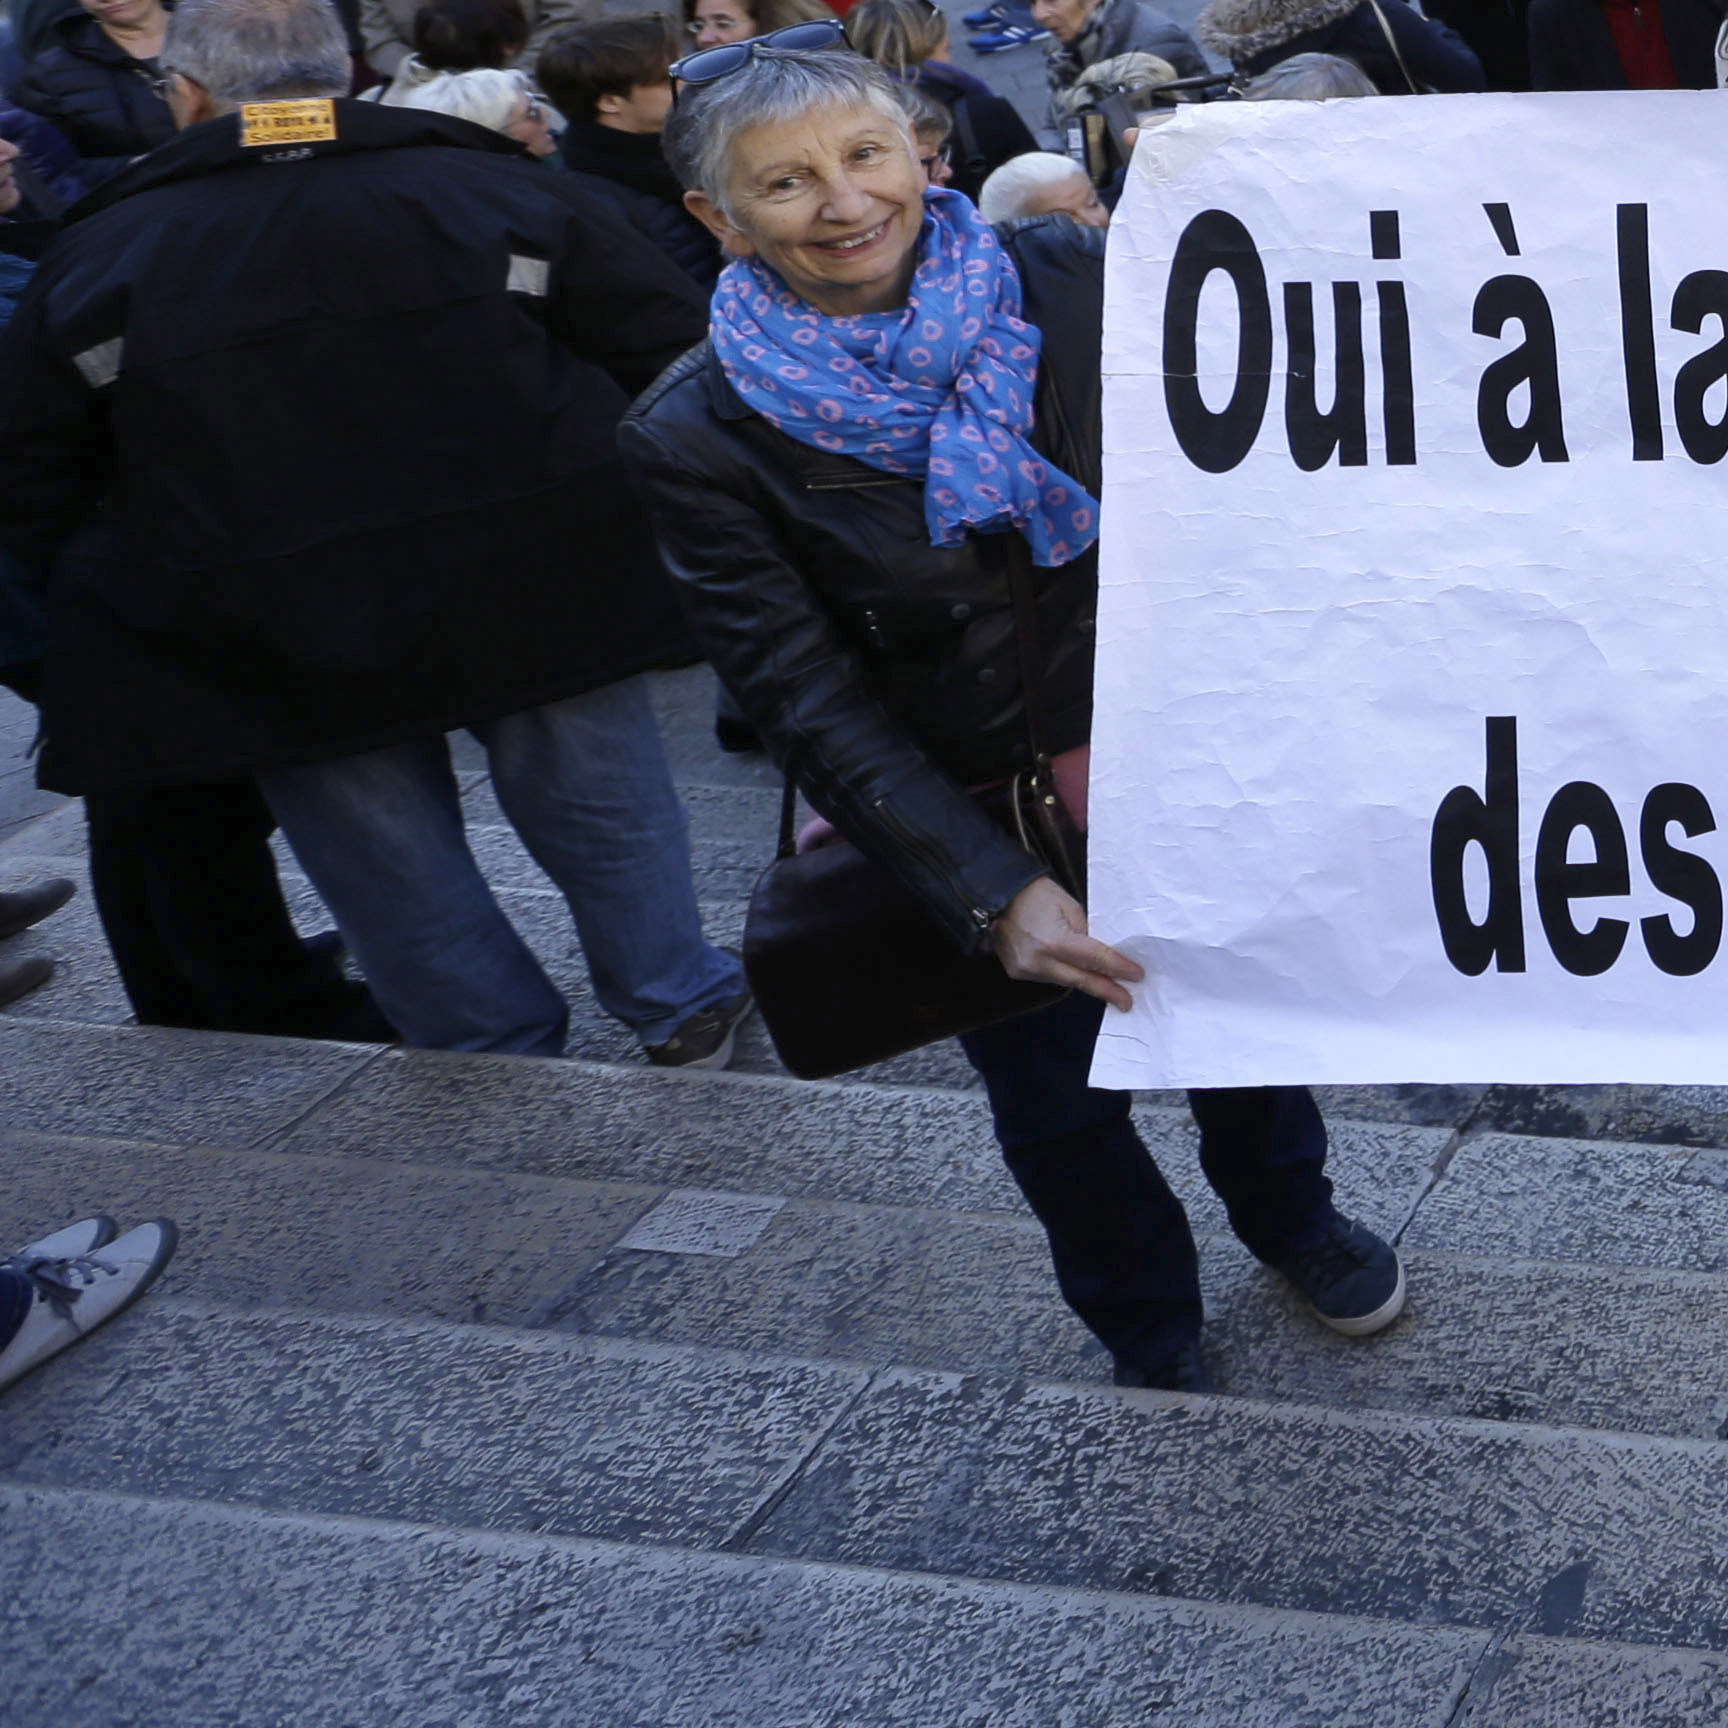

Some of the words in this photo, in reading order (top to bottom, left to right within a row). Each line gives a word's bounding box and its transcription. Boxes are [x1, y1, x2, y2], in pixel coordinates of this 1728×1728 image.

[1163, 210, 1417, 474] Oui
[1473, 202, 1570, 468] à
[1431, 715, 1724, 977] des
